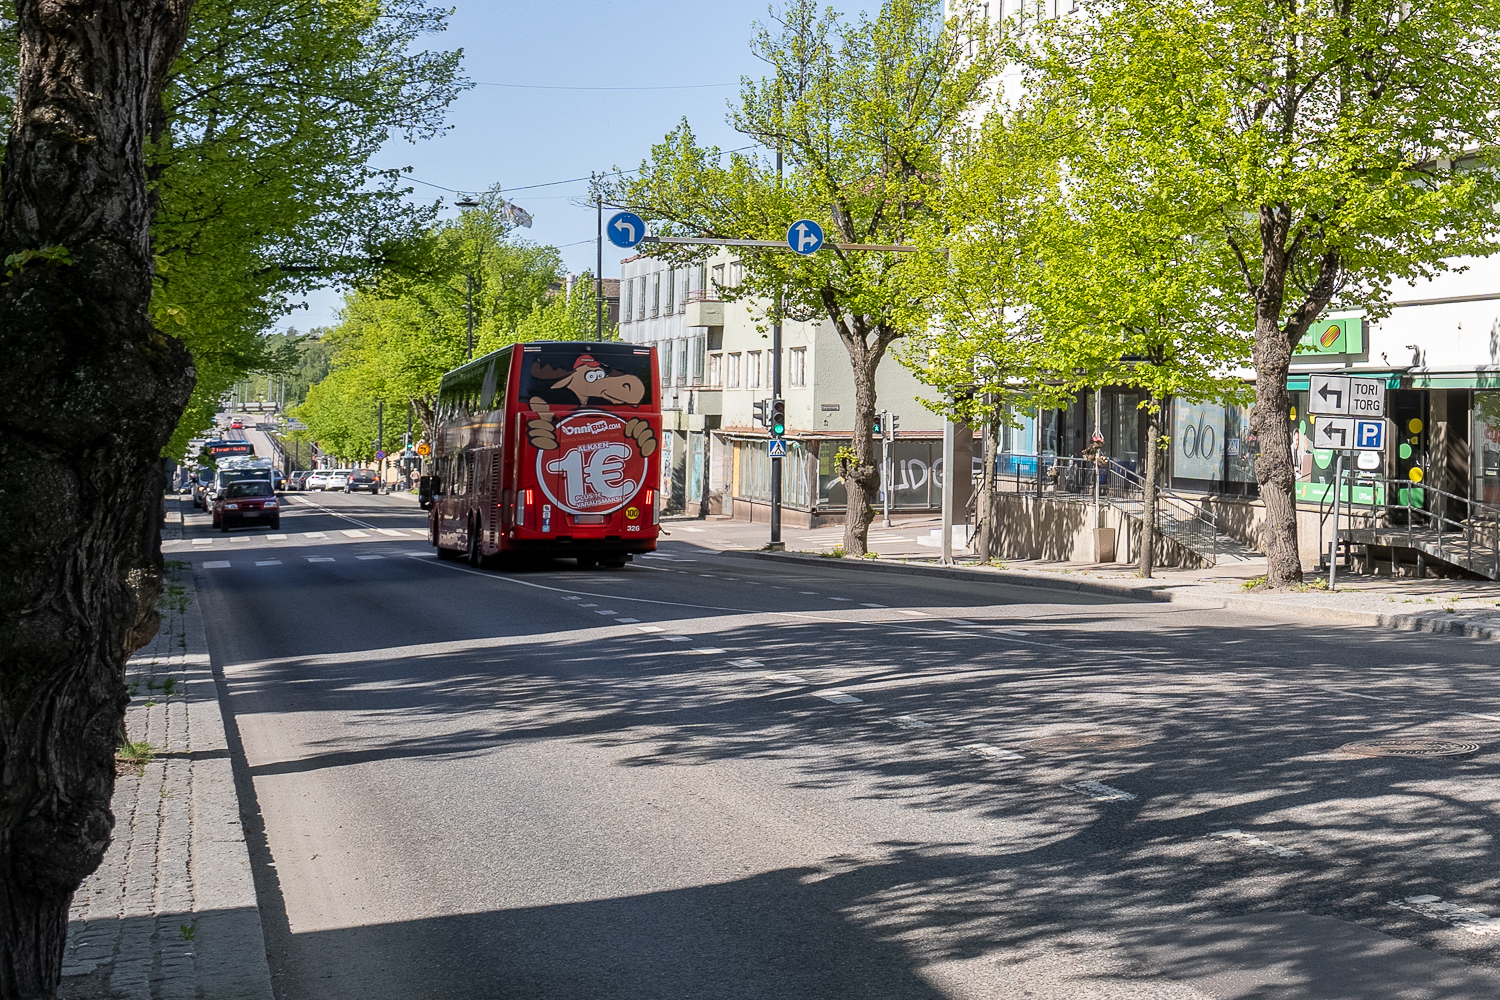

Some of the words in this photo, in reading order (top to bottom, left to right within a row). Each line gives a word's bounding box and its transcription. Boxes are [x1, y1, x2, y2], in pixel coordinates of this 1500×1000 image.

[1355, 383, 1378, 396] TORI
[1354, 399, 1380, 411] TORG
[578, 442, 609, 452] ALKAEN
[546, 442, 637, 508] 1€
